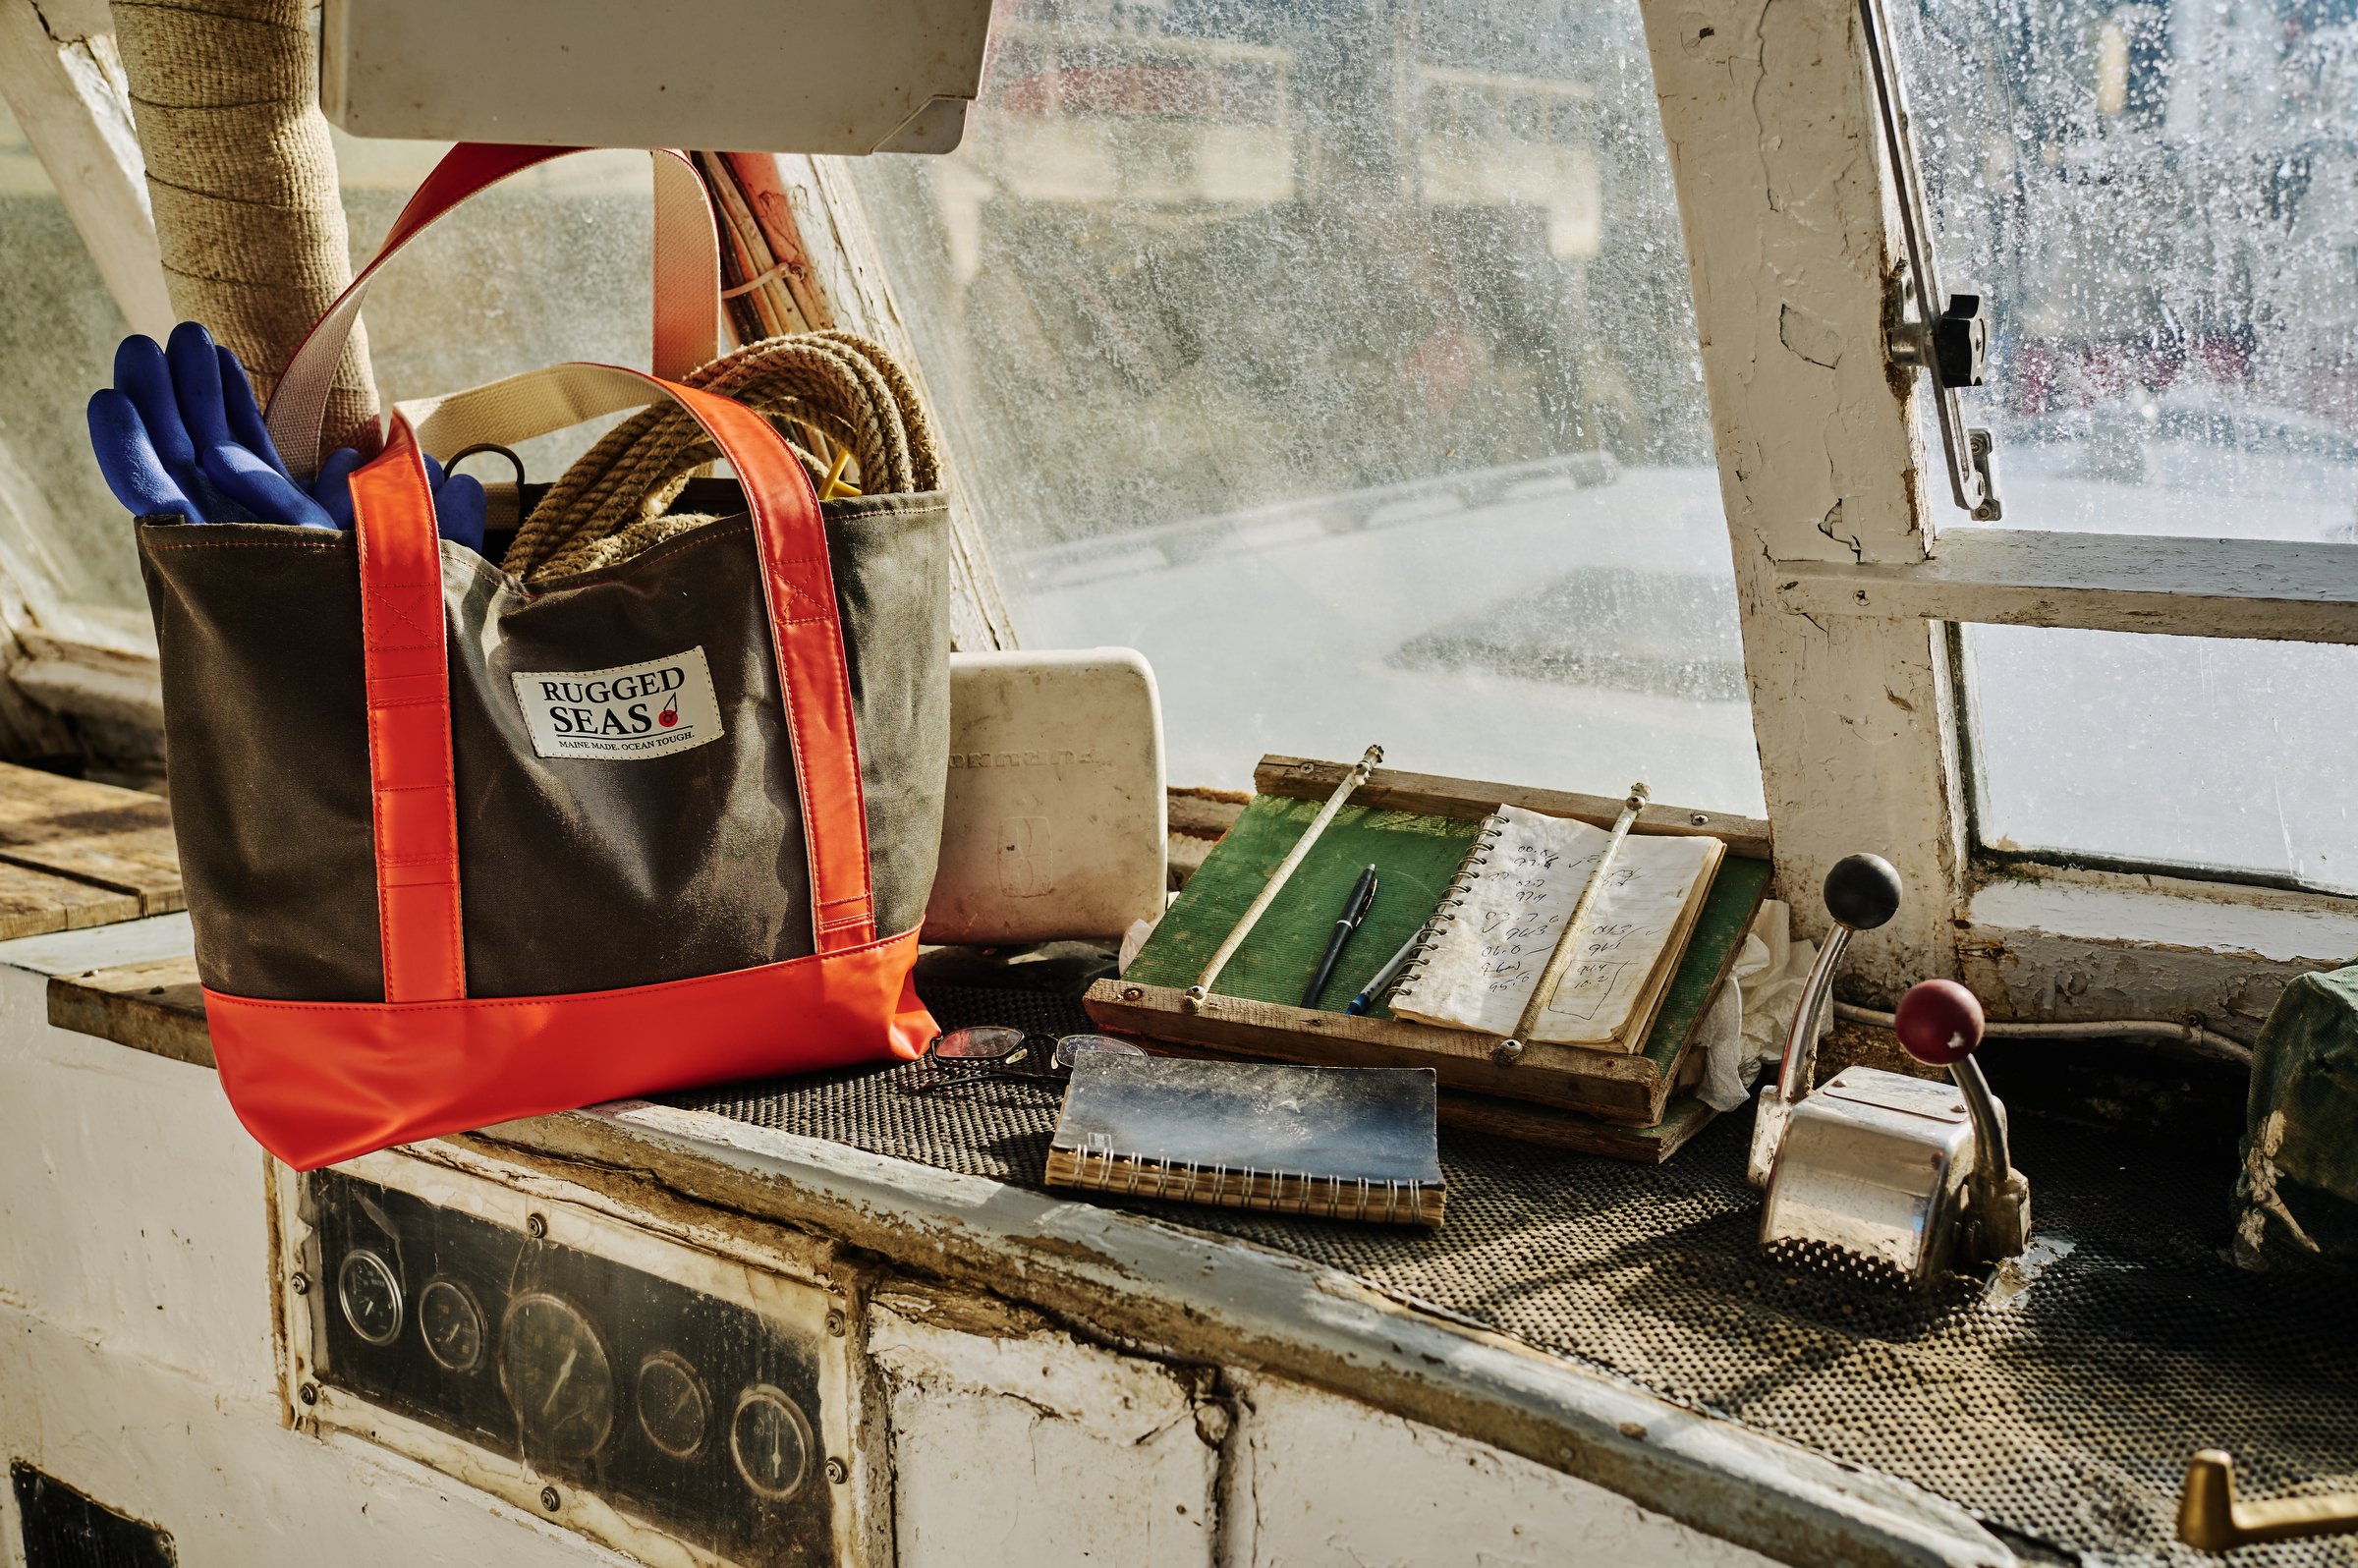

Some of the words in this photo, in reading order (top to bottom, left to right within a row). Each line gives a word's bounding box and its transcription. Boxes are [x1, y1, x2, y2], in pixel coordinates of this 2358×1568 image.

[538, 667, 685, 703] RUGGED
[549, 703, 652, 735] SEAS
[559, 740, 590, 750] MAINE
[591, 742, 620, 751] MADE.
[622, 740, 654, 751] OCEAN
[654, 732, 694, 746] TOUGH.
